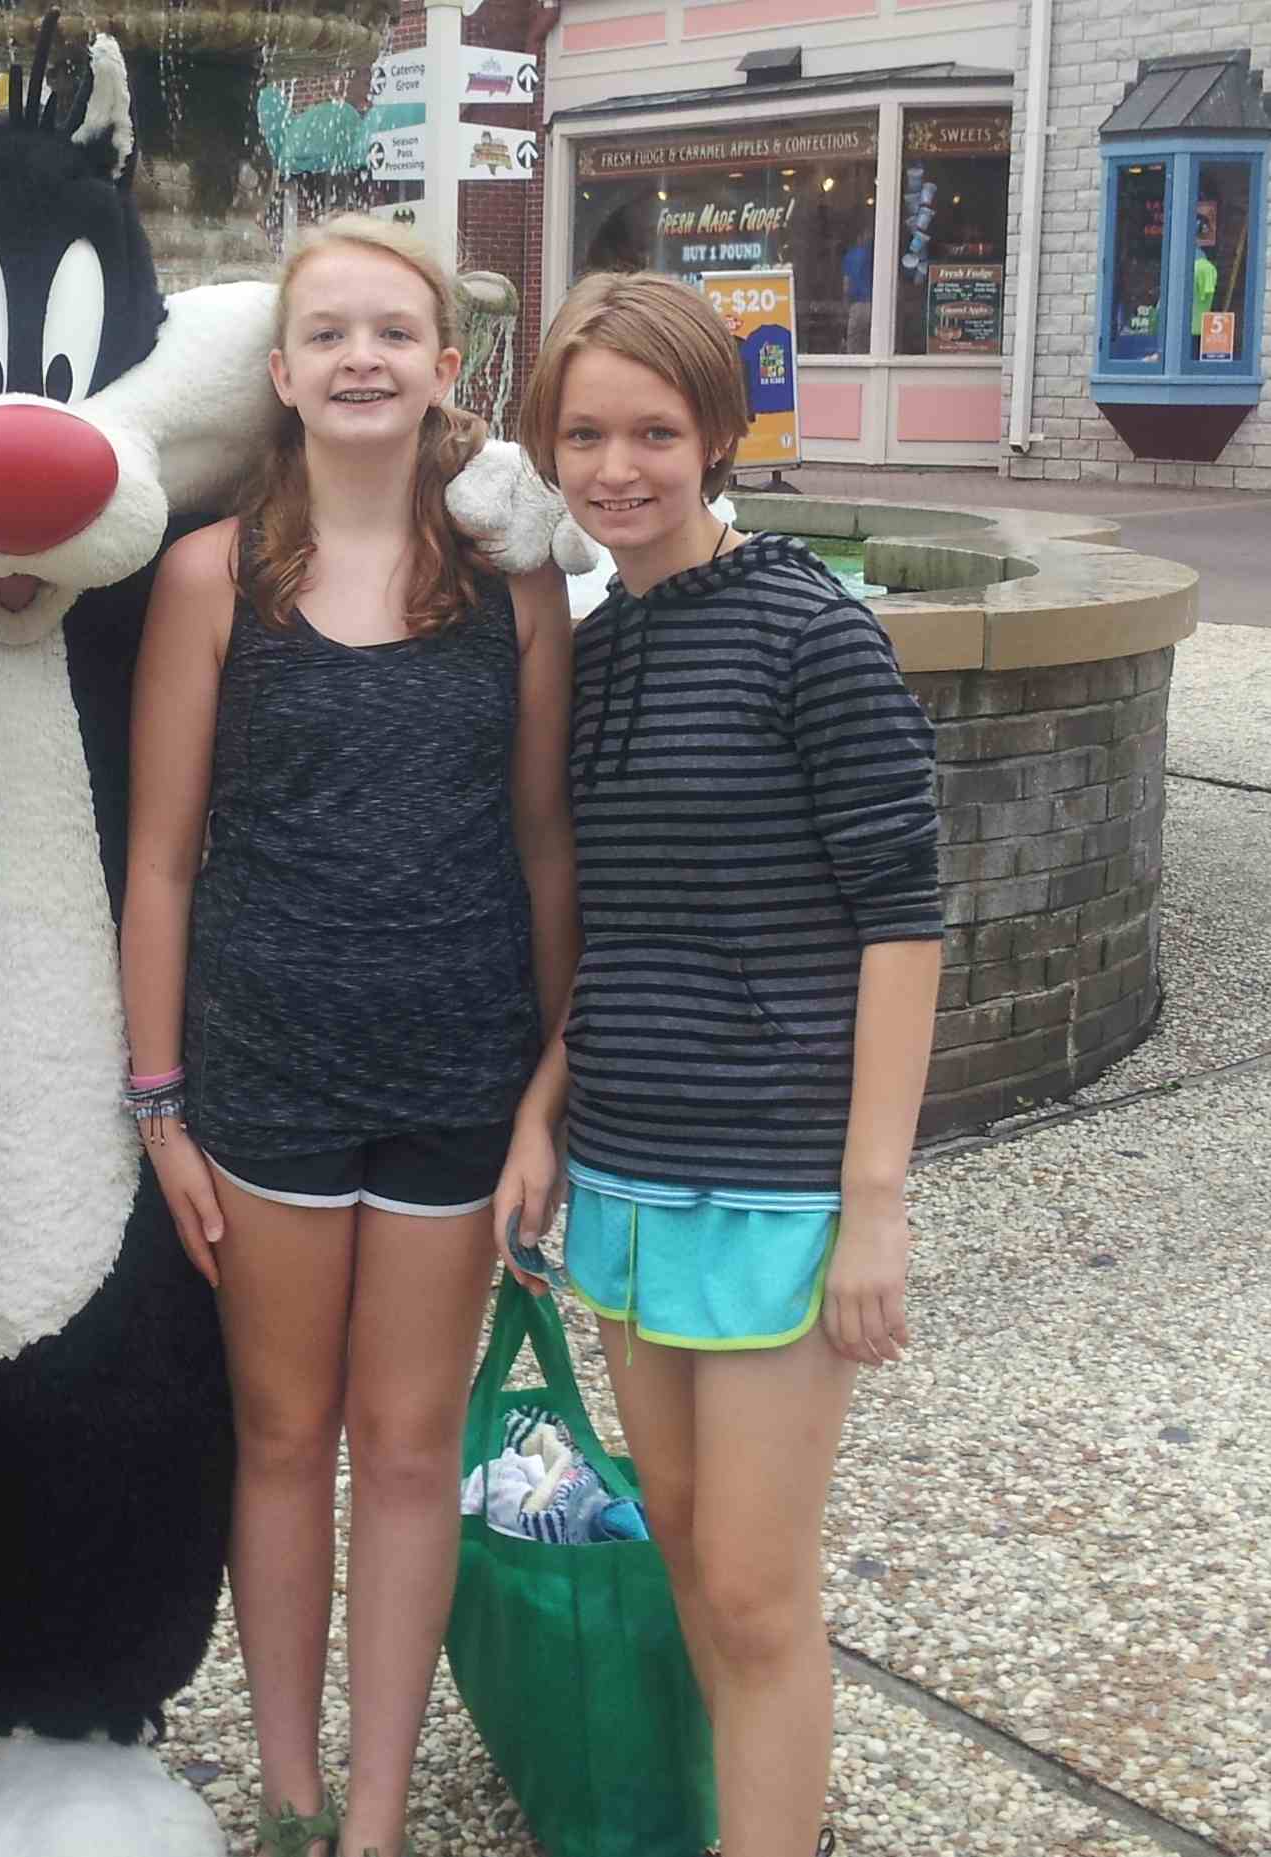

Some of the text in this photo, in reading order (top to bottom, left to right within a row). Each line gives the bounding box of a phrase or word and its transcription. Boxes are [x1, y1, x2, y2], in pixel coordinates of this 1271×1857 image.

[391, 63, 426, 77] Catering
[395, 79, 420, 92] Grove
[392, 136, 419, 147] Season
[939, 128, 991, 142] SWEETS
[396, 149, 413, 158] Pass
[601, 151, 632, 168] FRESH
[635, 148, 666, 165] FUDGE
[679, 143, 726, 161] CARAMEL
[730, 140, 769, 158] APPLES
[785, 131, 859, 153] CONFECTIONS
[385, 160, 425, 172] Processing
[697, 203, 736, 234] MADE
[682, 242, 761, 262] BUY 1 POUND
